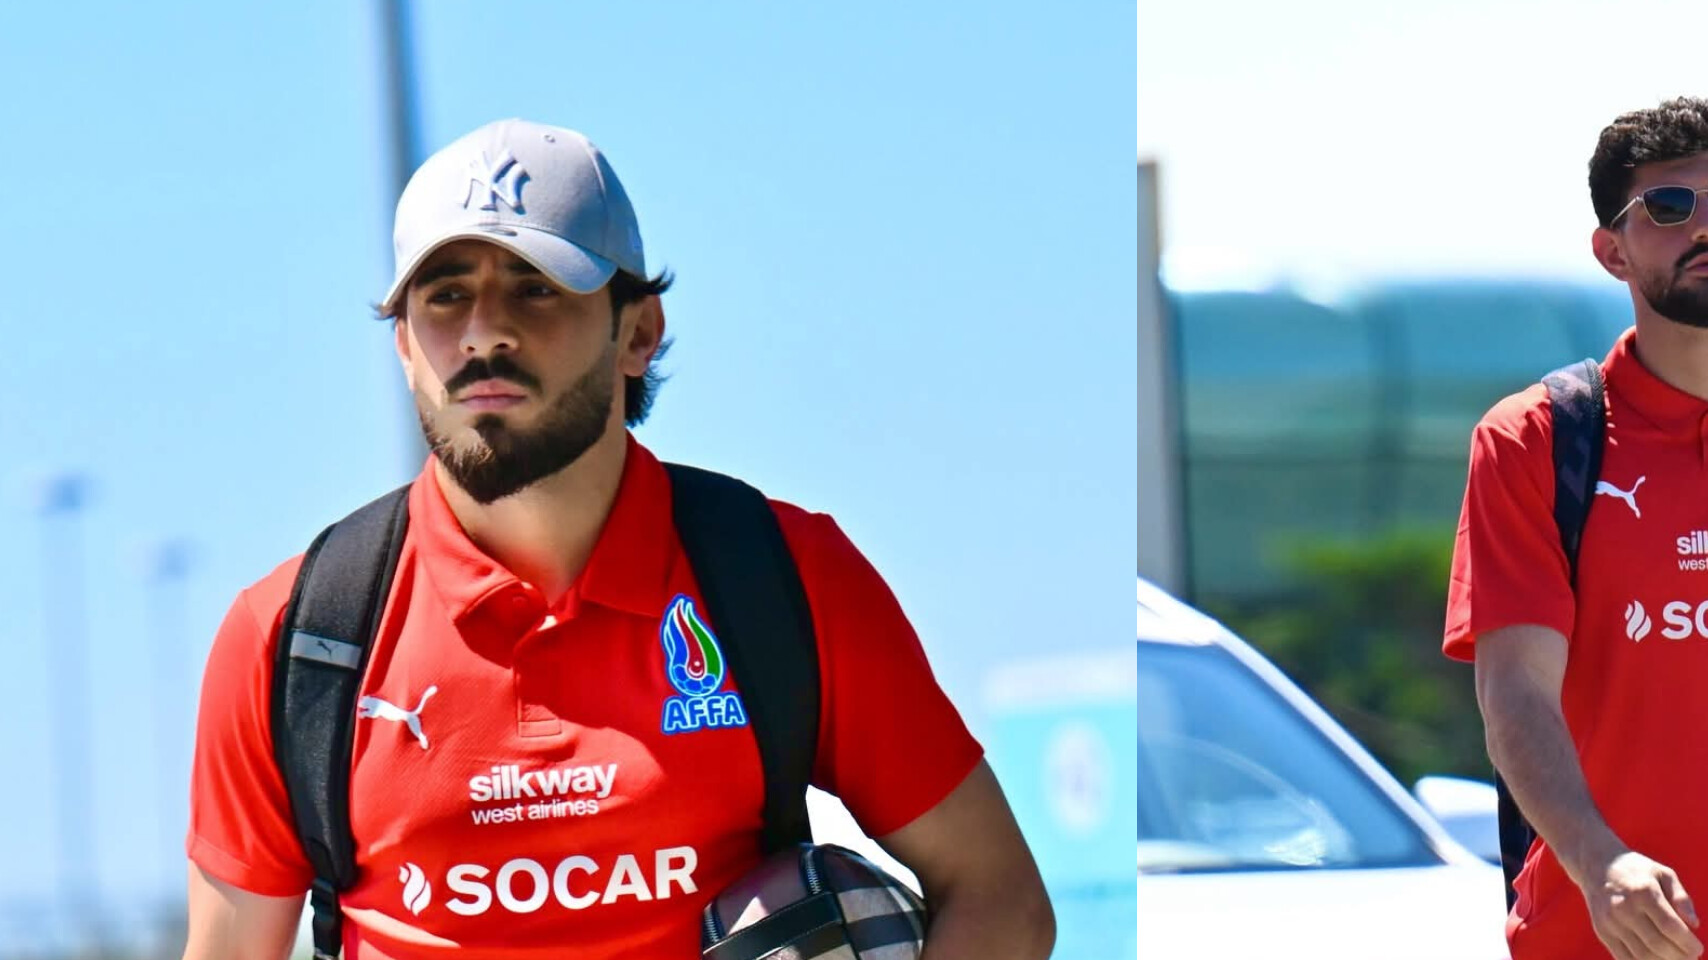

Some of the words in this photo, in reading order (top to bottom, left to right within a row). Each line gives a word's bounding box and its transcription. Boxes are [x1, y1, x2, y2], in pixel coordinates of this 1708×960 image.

[463, 149, 531, 215] NY
[662, 694, 747, 732] AFFA
[469, 763, 617, 802] silkway
[472, 802, 524, 825] west
[528, 798, 600, 820] airlines
[445, 846, 698, 916] SOCAR
